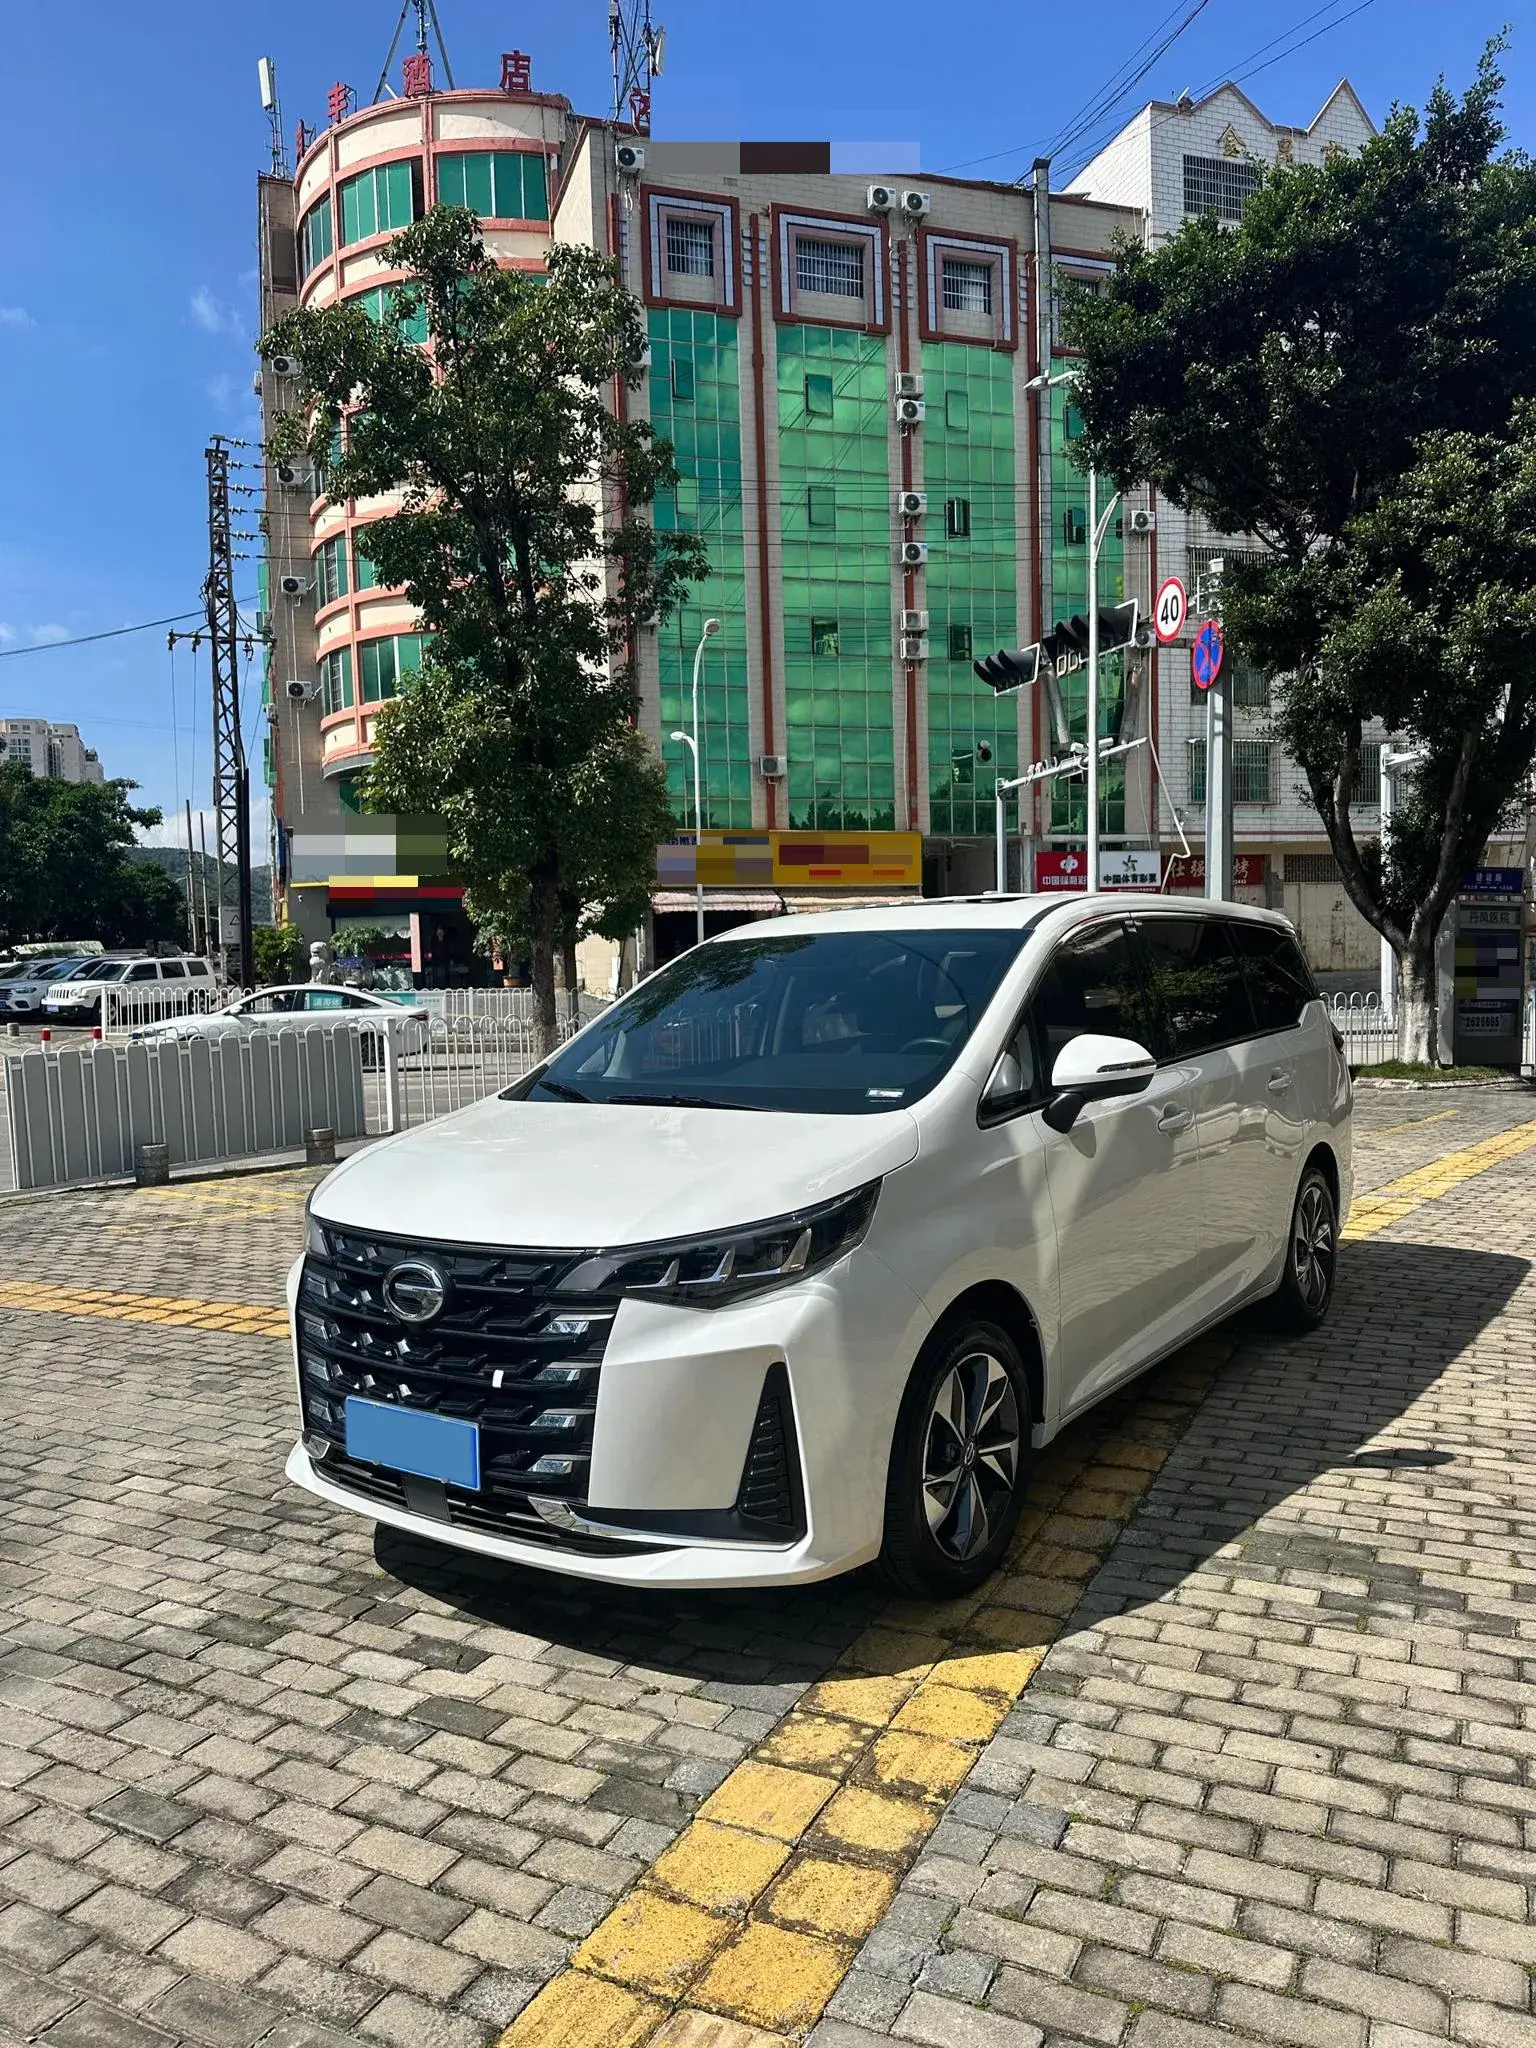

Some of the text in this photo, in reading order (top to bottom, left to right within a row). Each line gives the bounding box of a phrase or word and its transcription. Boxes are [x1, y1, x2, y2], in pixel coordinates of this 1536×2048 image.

[1161, 595, 1179, 624] 40
[1103, 873, 1157, 885] 中国体育彩票
